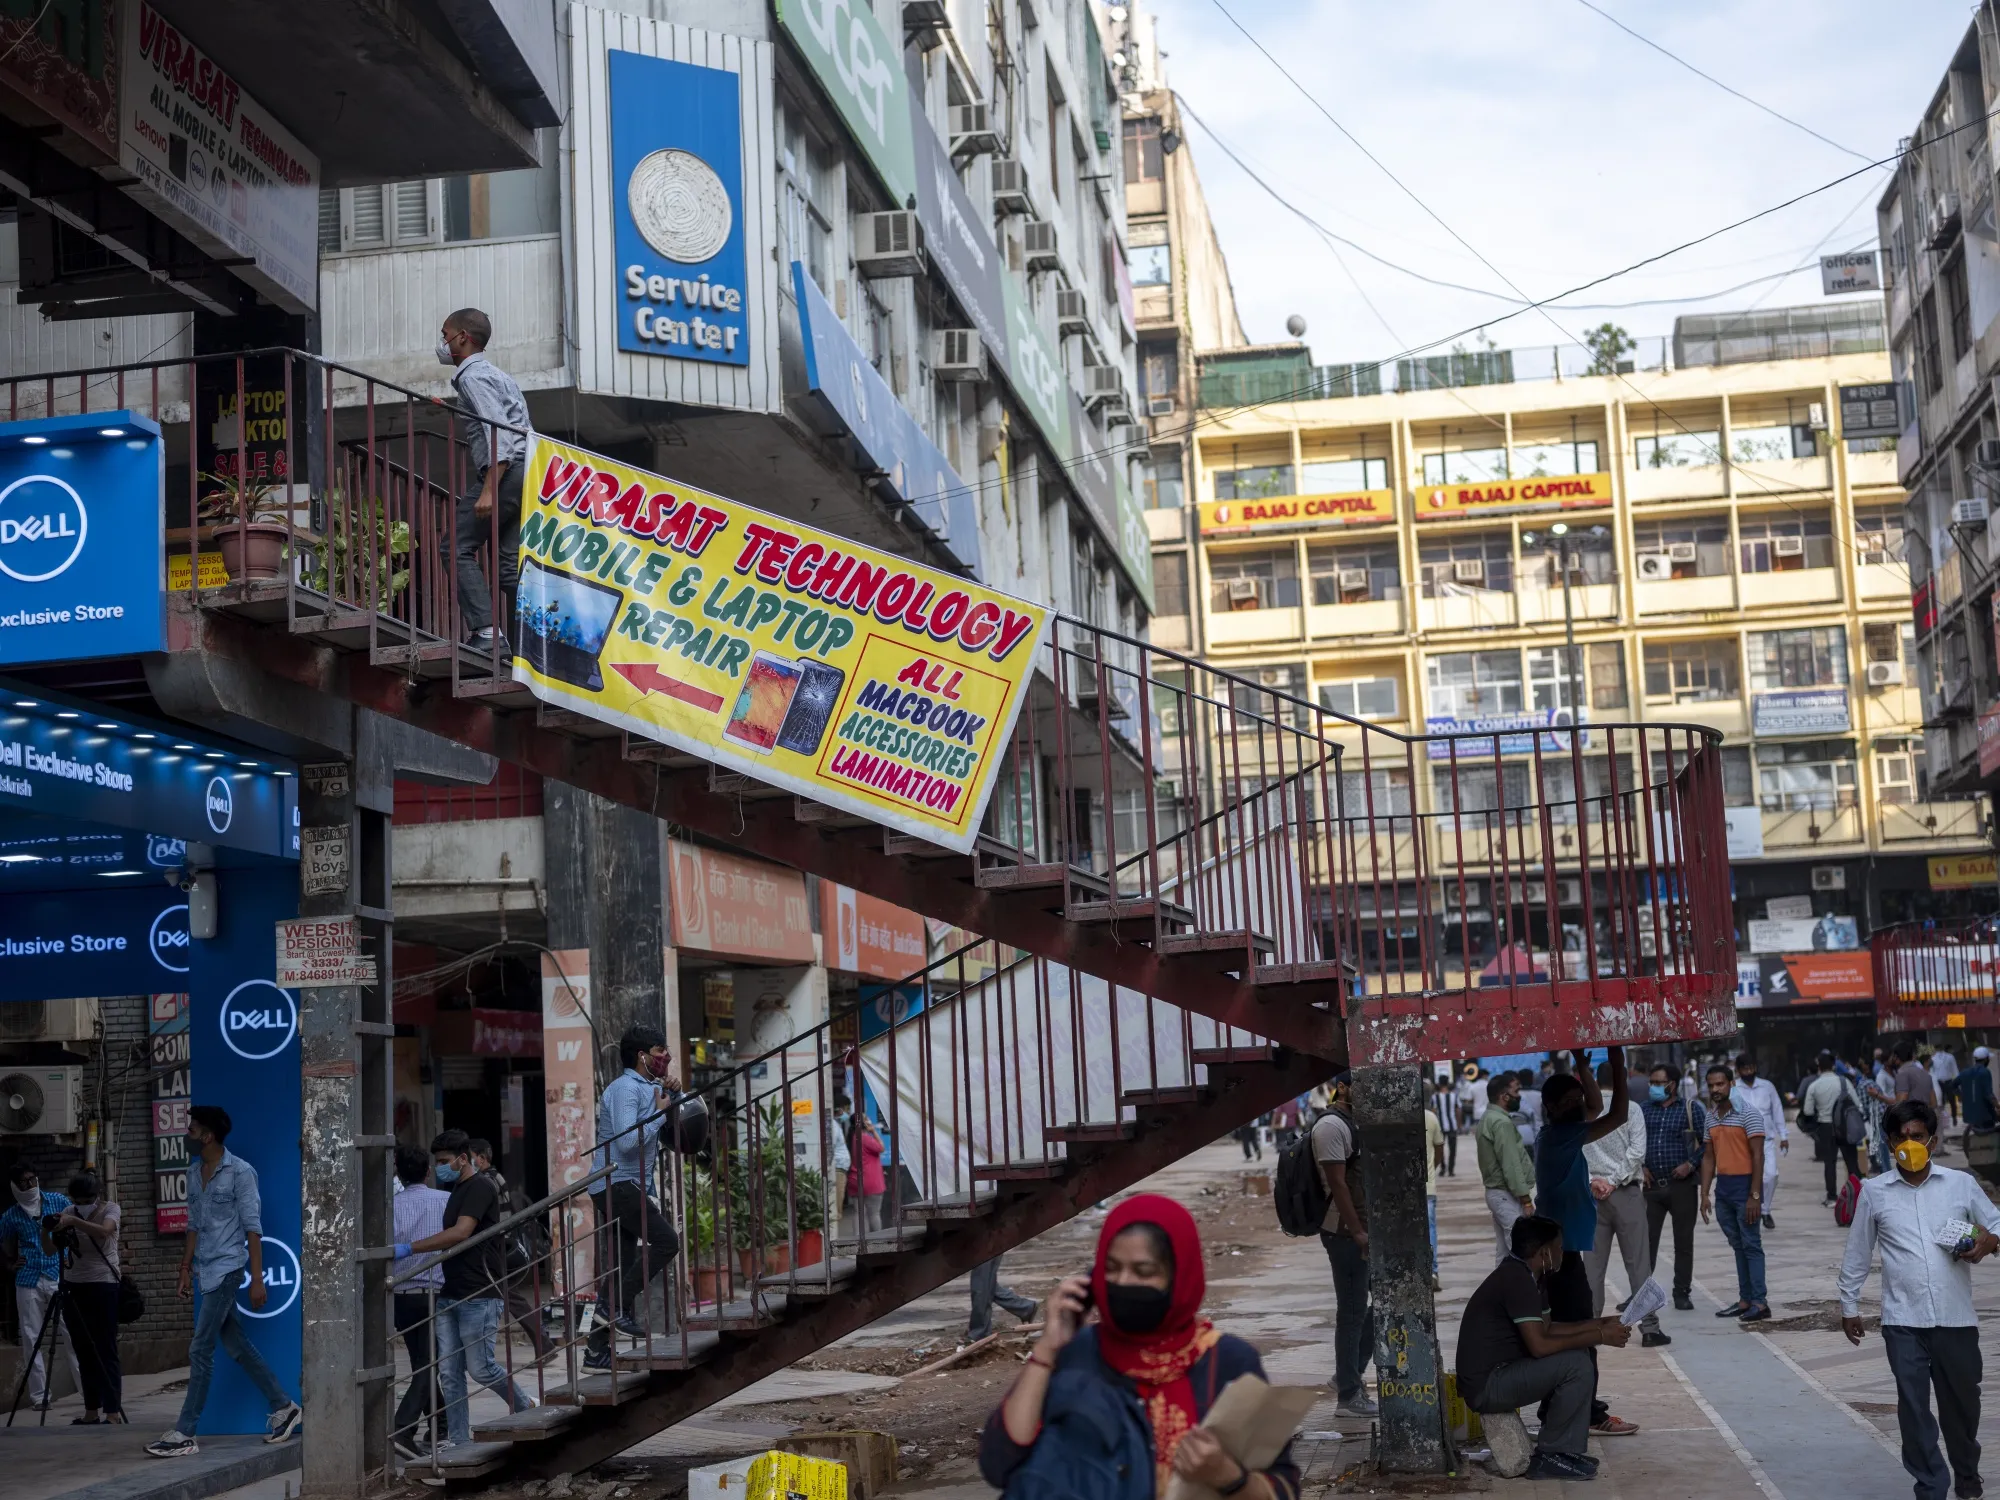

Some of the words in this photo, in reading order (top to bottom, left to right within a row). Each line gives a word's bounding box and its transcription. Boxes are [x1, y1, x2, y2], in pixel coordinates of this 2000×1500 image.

[139, 1, 241, 132] VIRASAT
[134, 110, 168, 153] Lenovo
[150, 84, 170, 118] ALL
[173, 101, 216, 153] MOBILE
[217, 138, 226, 161] &
[227, 146, 266, 188] LAPTOP
[191, 161, 205, 179] DELL
[1826, 254, 1872, 269] offices
[626, 264, 741, 312] Service
[635, 307, 740, 351] Center
[1016, 305, 1060, 432] acer
[217, 390, 286, 415] LAPTOP
[214, 451, 267, 479] SALE
[1458, 487, 1515, 505] BAJAJ
[1520, 480, 1595, 500] CAPITAL
[1243, 503, 1299, 521] BAJAJ
[1304, 497, 1377, 516] CAPITAL
[0, 512, 76, 544] DELL
[171, 567, 209, 579] TEMPRED
[537, 454, 728, 557] VIRASAT
[734, 523, 1033, 662] TECHNOLOGY
[175, 578, 207, 589] LAPTP
[520, 512, 672, 597] MOBILE
[668, 567, 703, 607] &
[702, 578, 854, 658] LAPTOP
[75, 605, 124, 620] Store
[617, 601, 752, 677] REPAIR
[755, 663, 777, 677] 12:45
[897, 658, 964, 700] ALL
[856, 679, 986, 748] MACBOOK
[1427, 722, 1472, 735] POOJA
[1474, 716, 1549, 733] COMPUTER
[838, 711, 979, 779] ACCESSORIES
[25, 745, 93, 783] Exclusive
[95, 762, 133, 792] Store
[829, 747, 962, 812] LAMINATION
[209, 796, 230, 815] DELL
[314, 843, 343, 856] P/g
[312, 861, 345, 874] Boys
[713, 909, 740, 945] Bank
[70, 933, 128, 952] Store
[286, 951, 306, 959] Start
[307, 951, 316, 959] @
[317, 948, 345, 958] Lowest
[311, 958, 348, 968] 3333/-
[229, 1008, 290, 1031] DELL
[774, 1455, 783, 1489] PROTECTION
[815, 1465, 823, 1499] PROTECTION
